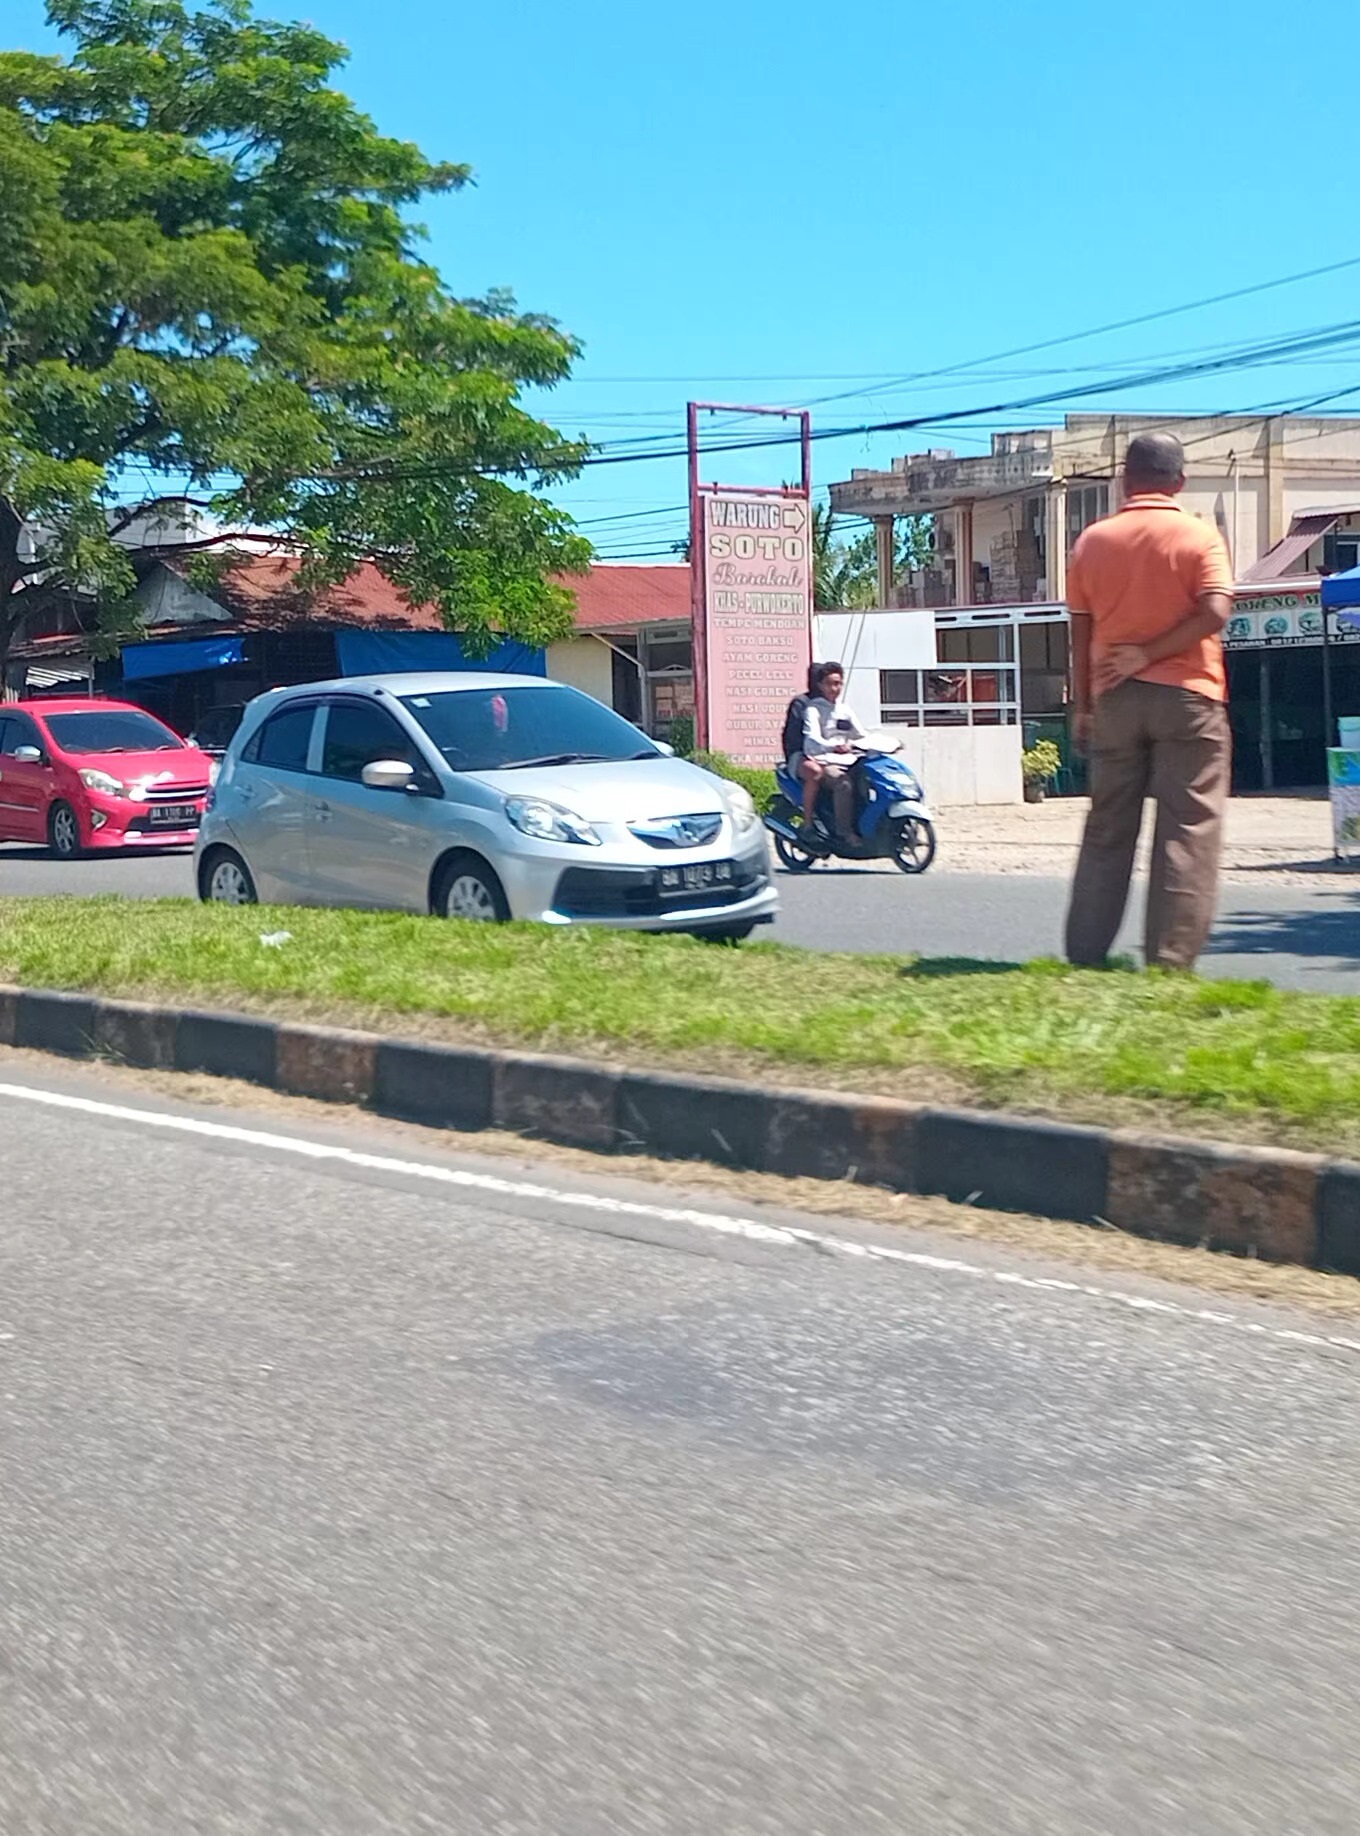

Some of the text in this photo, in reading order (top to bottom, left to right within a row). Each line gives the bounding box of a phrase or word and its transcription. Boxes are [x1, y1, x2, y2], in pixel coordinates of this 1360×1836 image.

[710, 500, 781, 530] WARUNG
[710, 533, 805, 562] SOTO
[712, 562, 804, 588] Barokah
[713, 591, 739, 614] KHAS
[744, 591, 805, 615] PURWOKERTO
[1232, 596, 1297, 611] ORENG
[713, 617, 806, 630] TEMPE MENDOAN
[726, 634, 794, 647] SOTO BAKSO
[722, 651, 799, 664] AYAM GORENG
[725, 685, 752, 697] NASI
[764, 719, 785, 730] AYA
